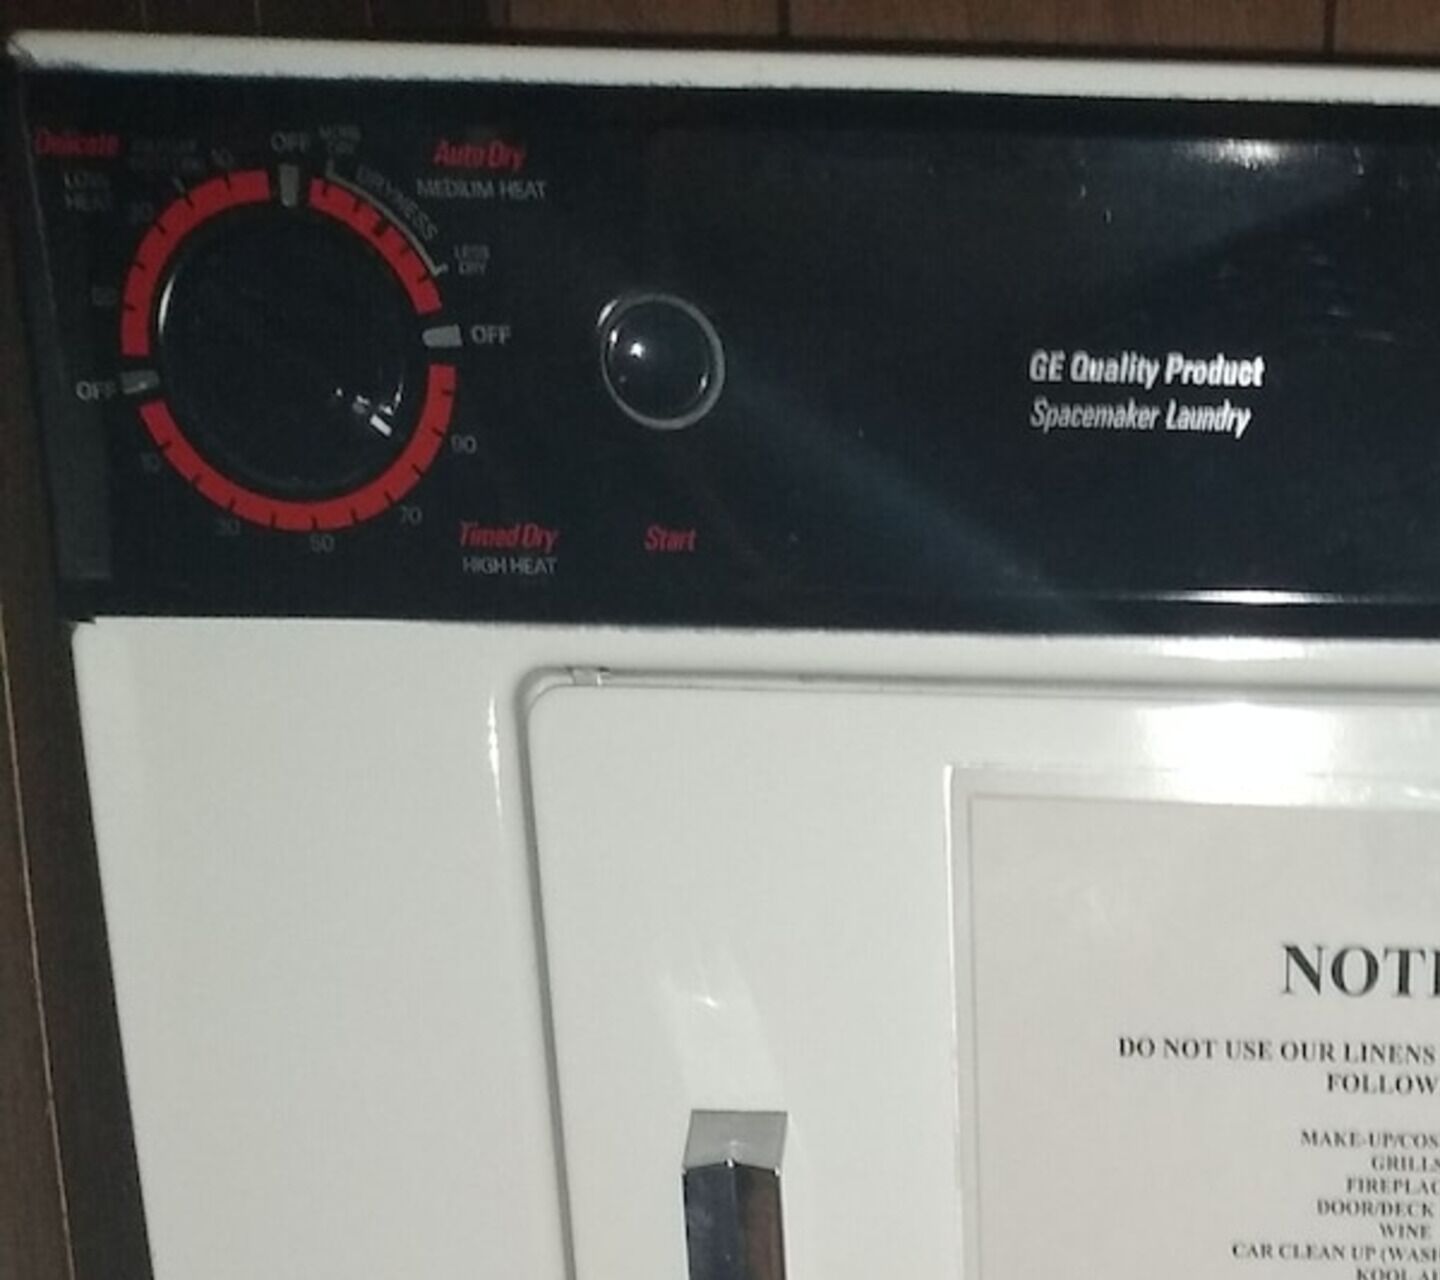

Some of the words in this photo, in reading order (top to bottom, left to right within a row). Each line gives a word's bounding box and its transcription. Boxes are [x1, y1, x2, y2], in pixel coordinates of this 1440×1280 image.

[416, 180, 496, 199] MEDIUM
[500, 181, 547, 200] HEAT
[470, 325, 511, 345] OFF
[1029, 348, 1066, 382] GE
[1070, 350, 1160, 390] Quality
[1164, 352, 1265, 388] Product
[1030, 395, 1160, 434] Spacemaker
[1165, 398, 1252, 439] Laundry
[459, 521, 520, 546] Timed
[522, 524, 560, 551] Dry
[645, 525, 697, 553] Start
[462, 557, 509, 575] HIGH
[510, 557, 558, 575] HEAT
[1119, 1037, 1155, 1057] DO
[1164, 1038, 1217, 1059] NOT
[1226, 1039, 1272, 1060] USE
[1280, 1041, 1335, 1062] OUR
[1344, 1042, 1435, 1065] LINENS
[1317, 1199, 1434, 1218] DOOR/DECK
[1379, 1222, 1431, 1240] WINE
[1232, 1243, 1273, 1259] CAR
[1278, 1243, 1345, 1260] CLEAN
[1351, 1244, 1376, 1262] UP
